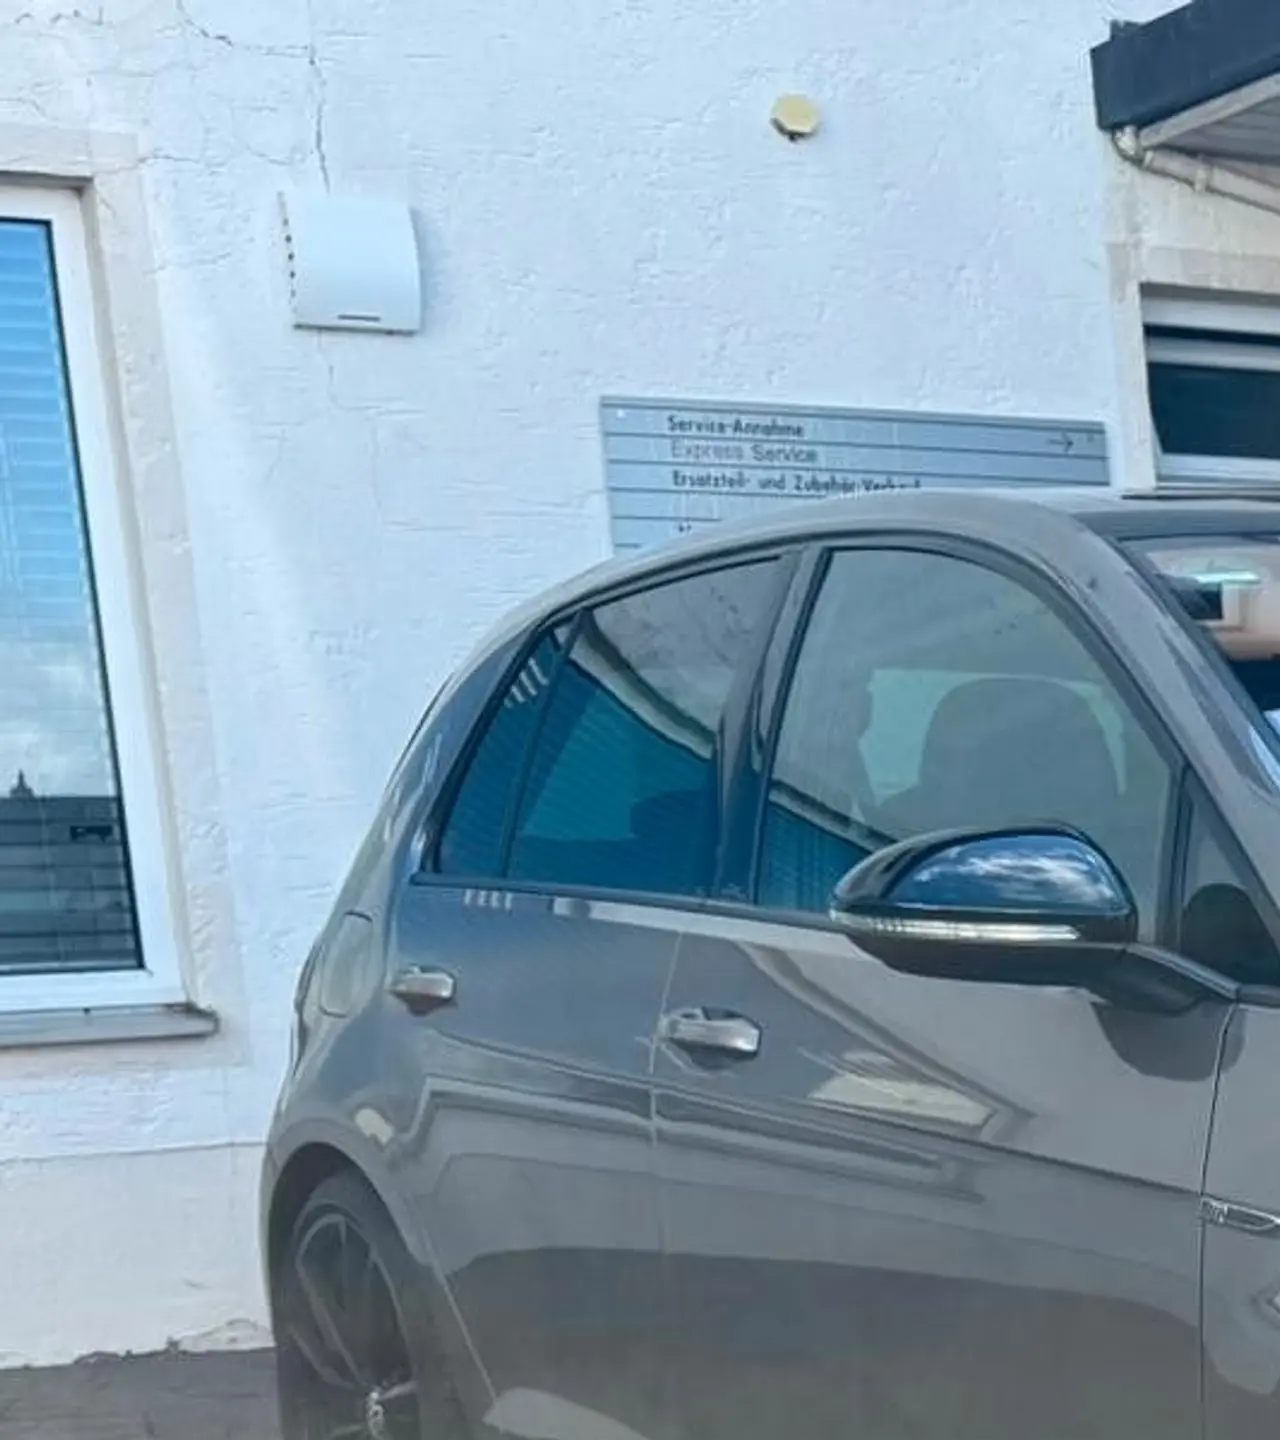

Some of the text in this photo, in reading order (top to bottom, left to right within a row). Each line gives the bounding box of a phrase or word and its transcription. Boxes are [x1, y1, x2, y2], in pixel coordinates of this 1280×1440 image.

[671, 440, 819, 463] Express Service
[758, 473, 786, 490] und
